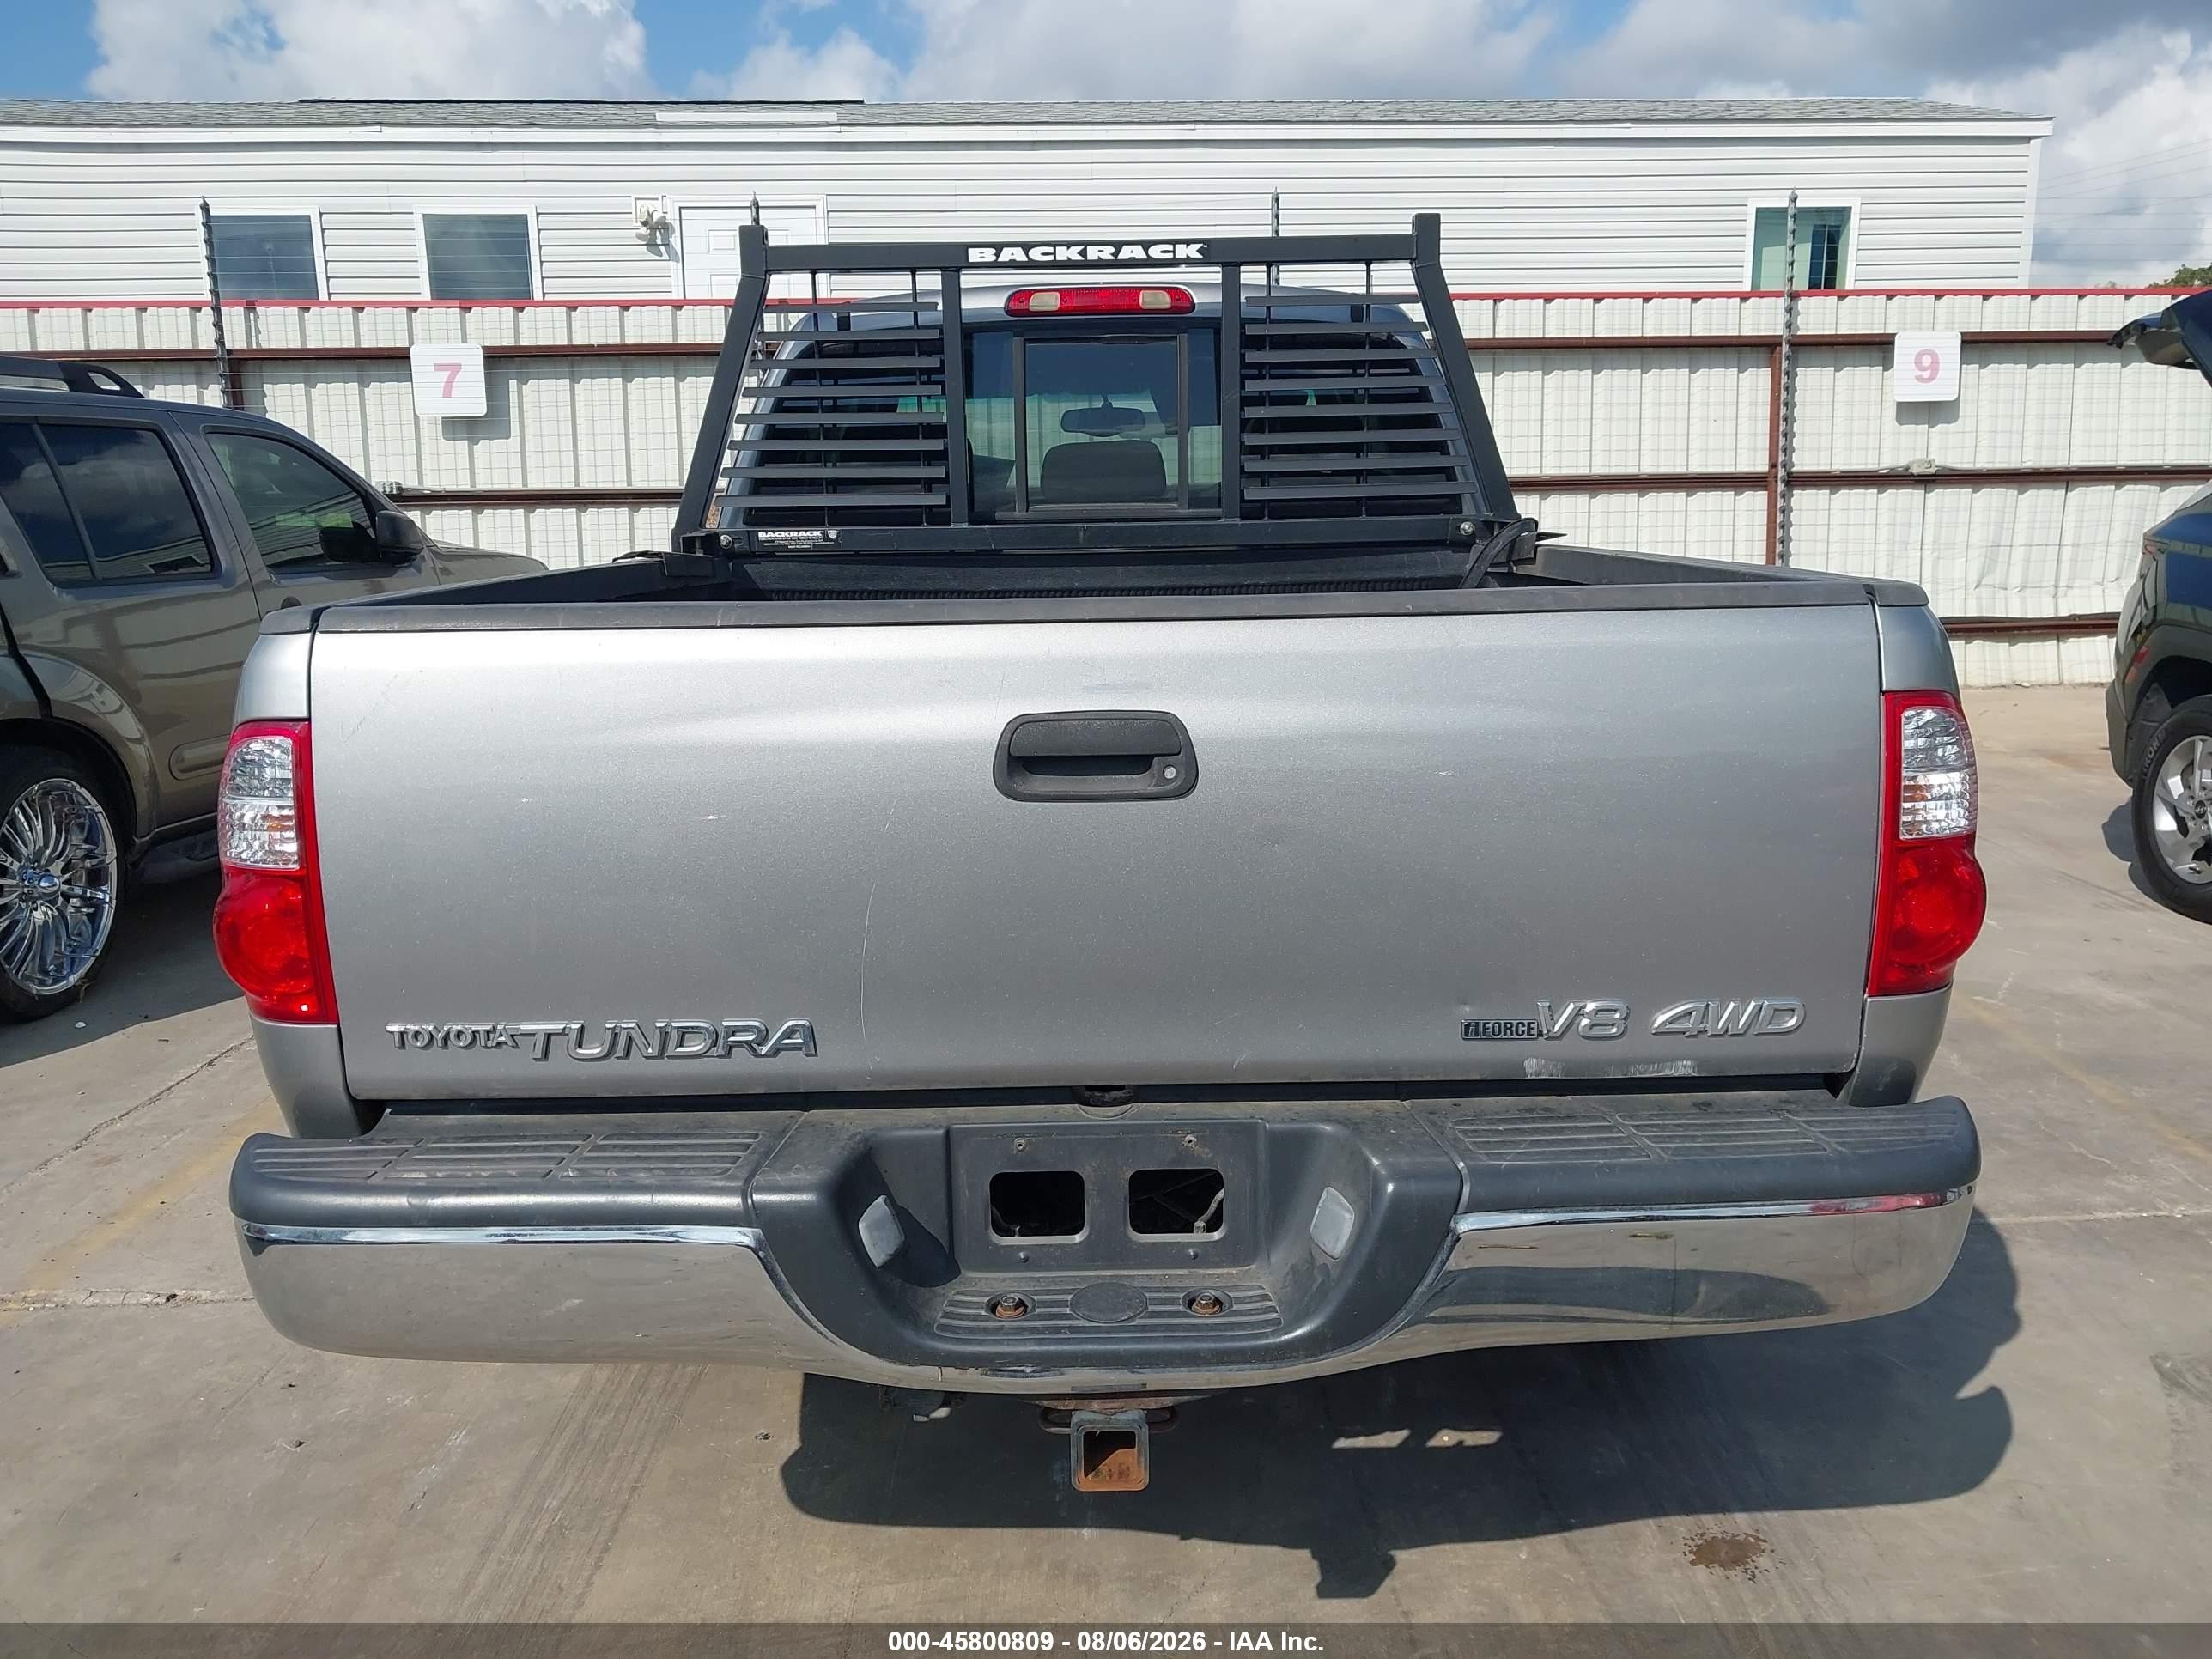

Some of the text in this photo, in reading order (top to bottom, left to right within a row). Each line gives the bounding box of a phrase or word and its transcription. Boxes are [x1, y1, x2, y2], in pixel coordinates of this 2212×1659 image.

[968, 243, 1204, 262] BACKRACK
[433, 362, 462, 398] 7
[1914, 349, 1940, 384] 9
[1537, 999, 1630, 1040] V8
[1650, 999, 1805, 1037] 4WD
[386, 1018, 817, 1060] TOYOTA TUNDRA
